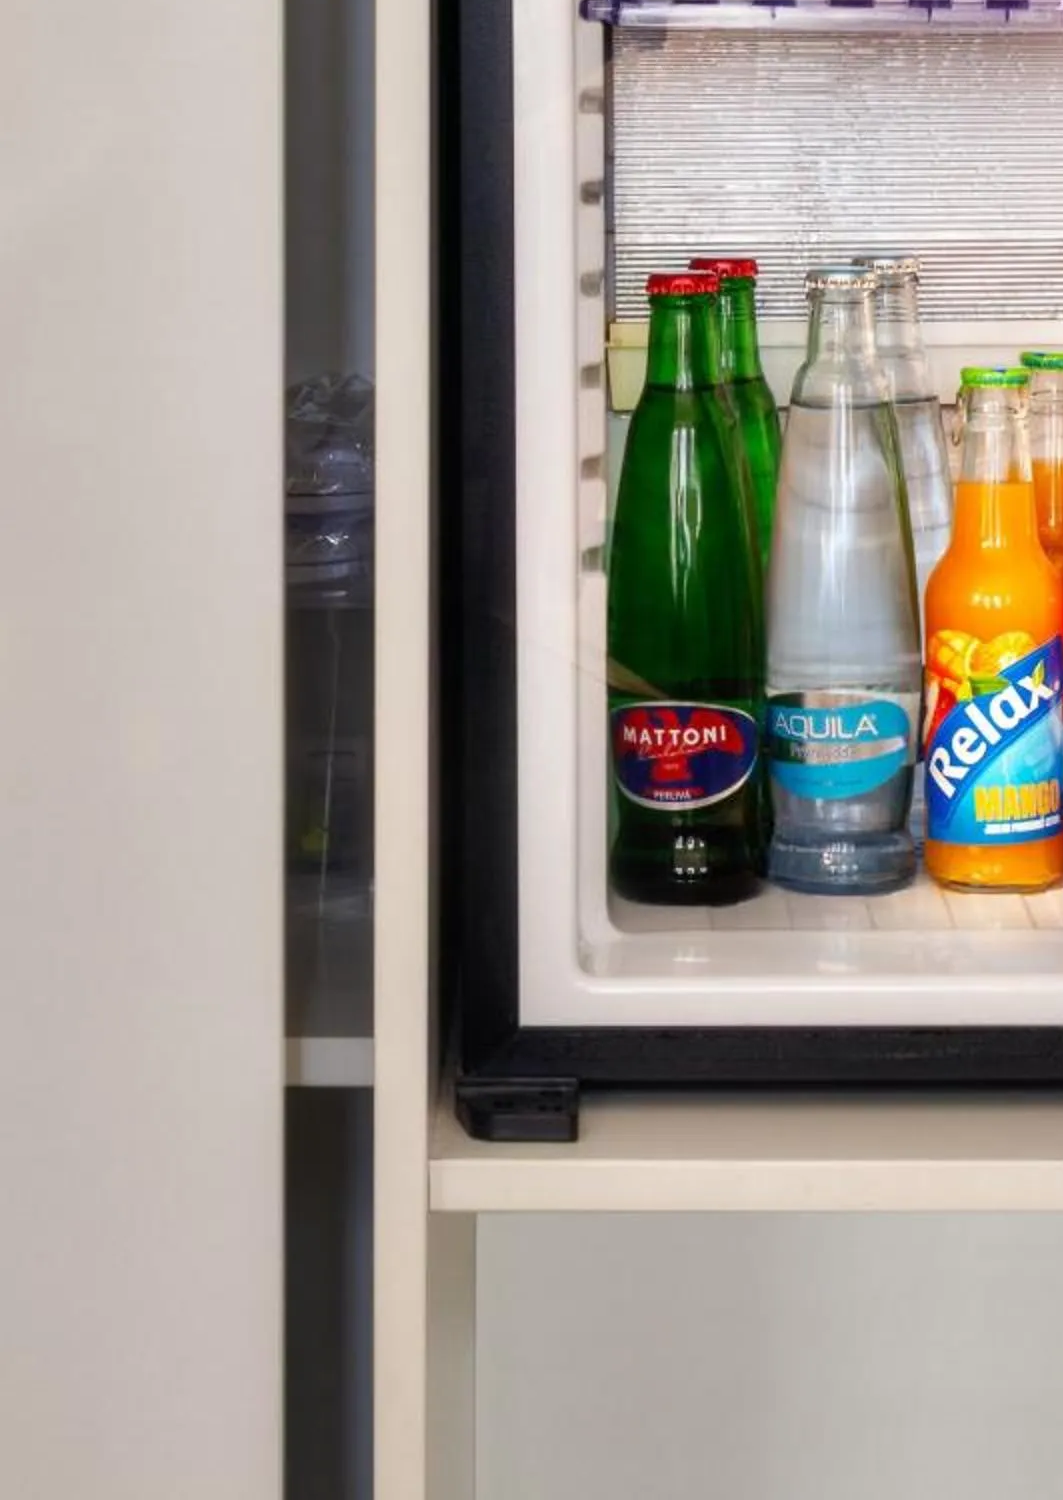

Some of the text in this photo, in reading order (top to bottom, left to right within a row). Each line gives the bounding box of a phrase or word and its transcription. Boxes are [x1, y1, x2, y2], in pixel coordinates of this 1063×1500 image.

[623, 724, 727, 746] MATTONI
[775, 712, 878, 739] AQUILA
[929, 673, 1055, 799] Relax
